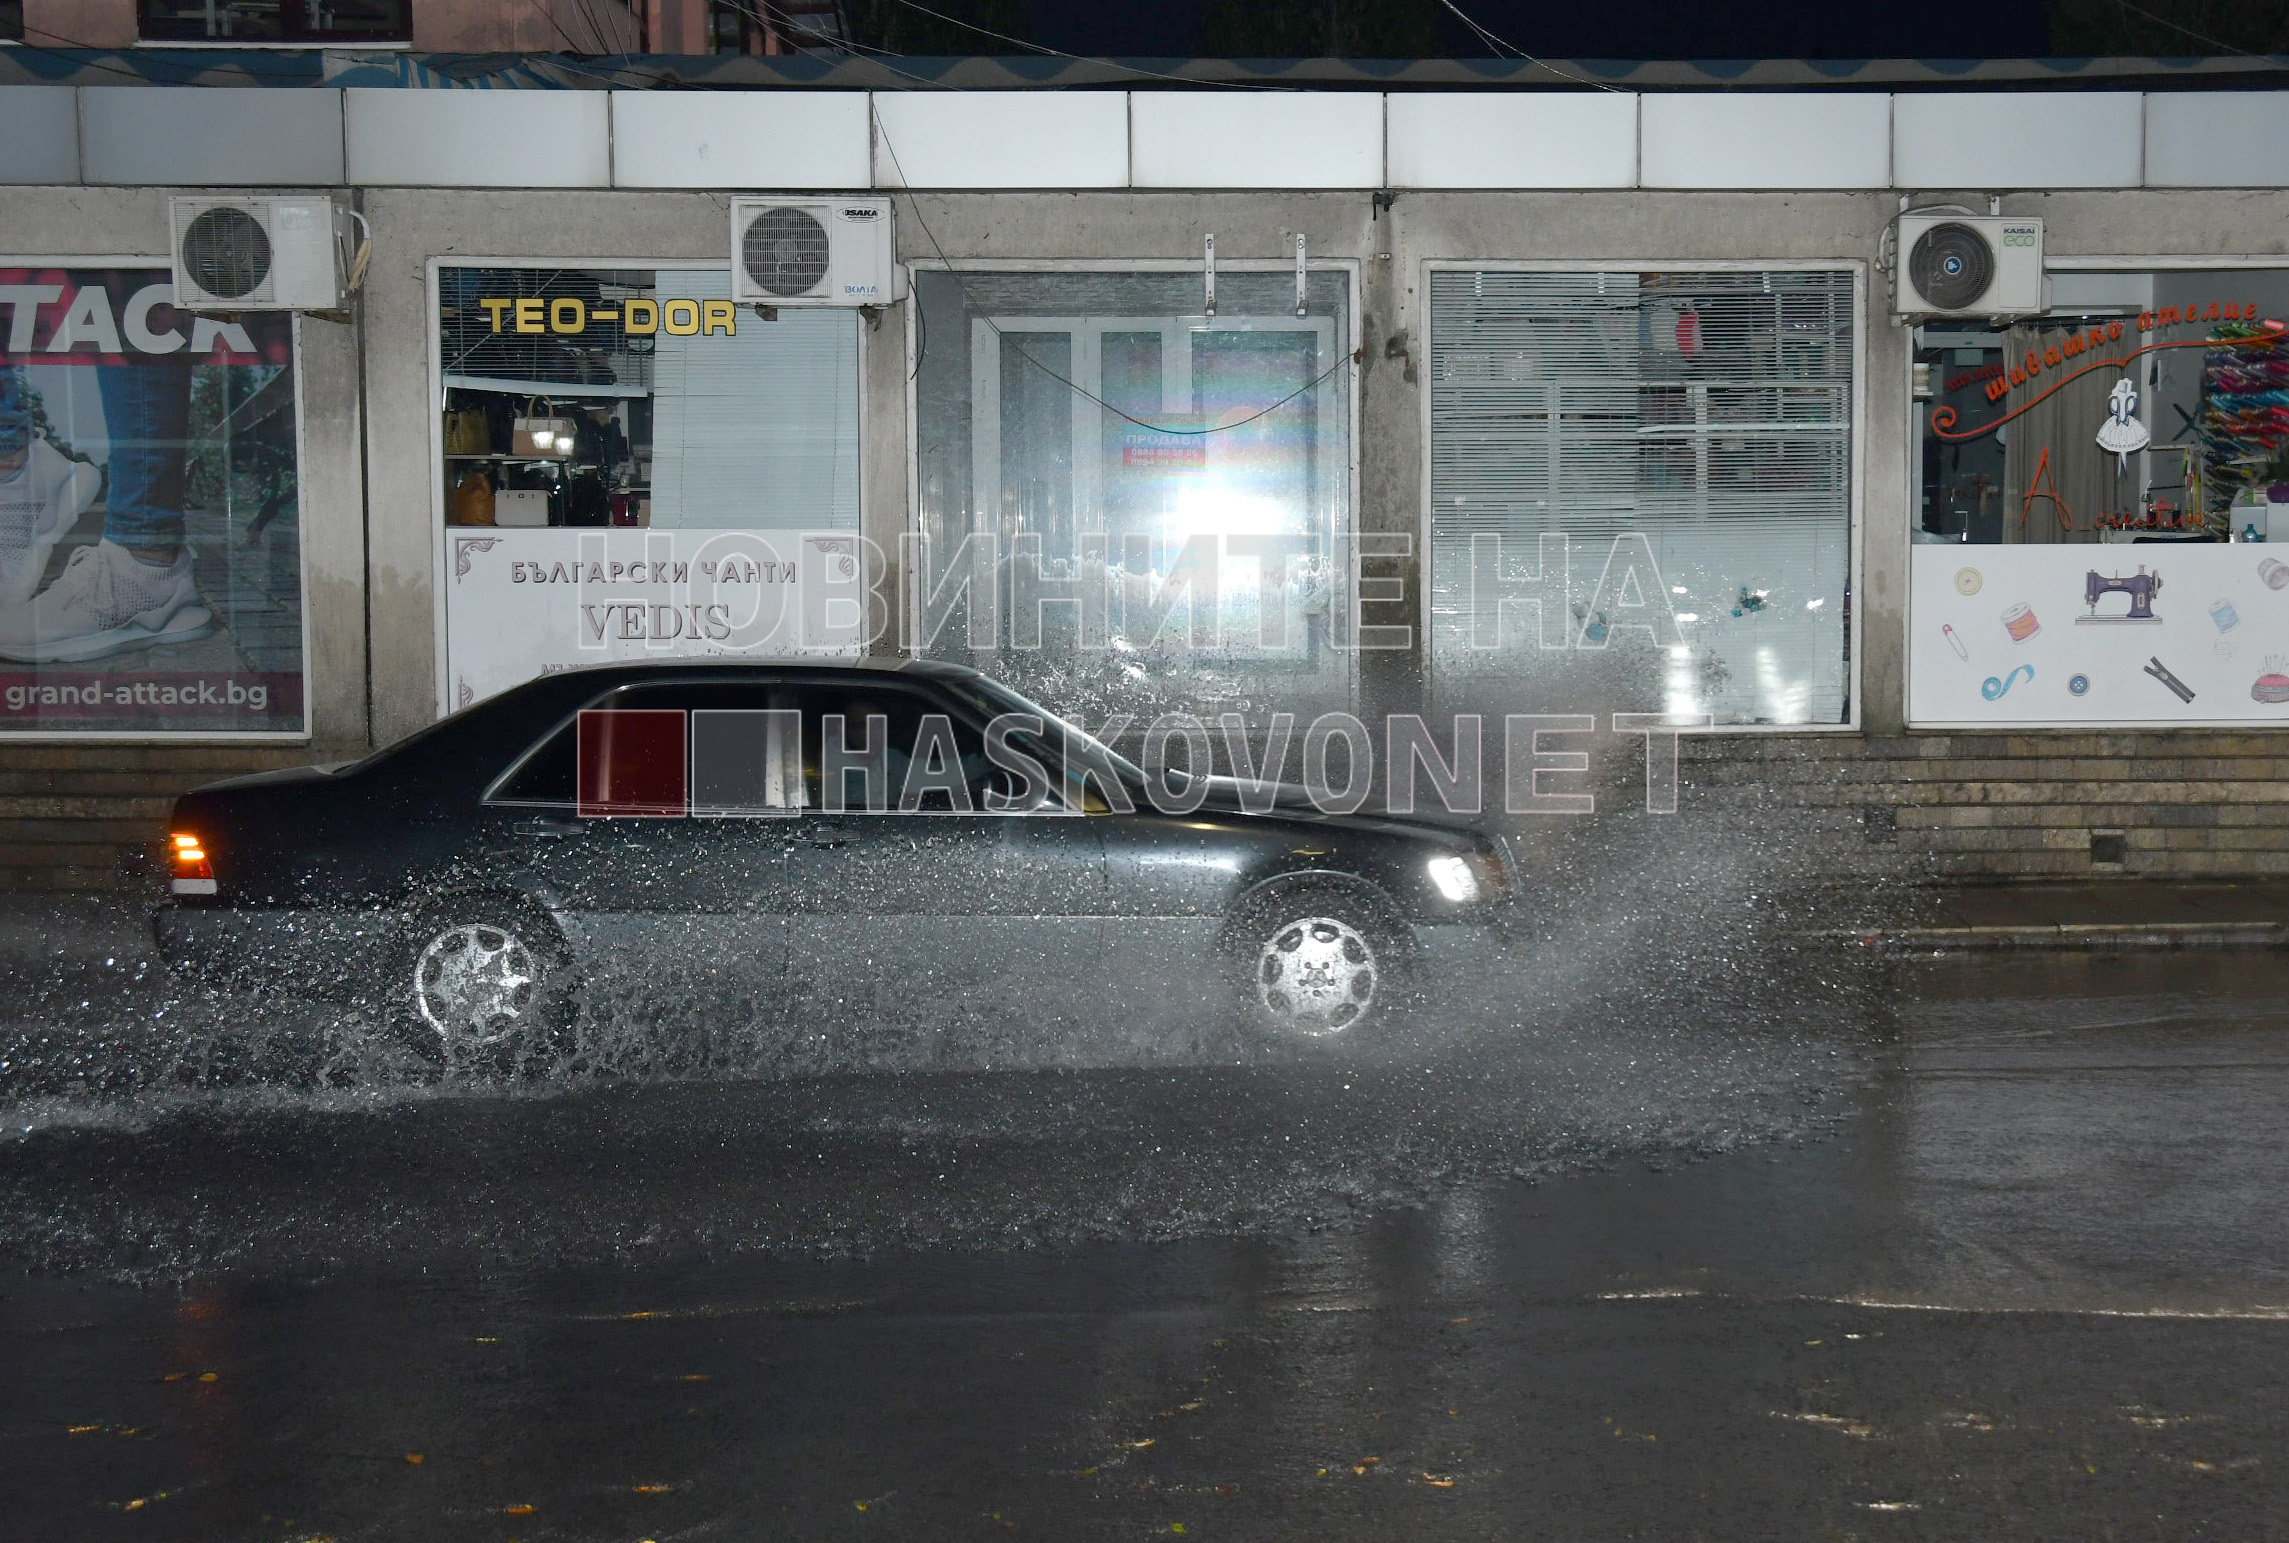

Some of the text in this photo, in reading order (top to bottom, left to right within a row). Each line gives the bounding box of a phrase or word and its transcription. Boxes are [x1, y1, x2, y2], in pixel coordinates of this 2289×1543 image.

[480, 298, 737, 336] TEO-DOR
[1985, 320, 2123, 402] шивашко
[2136, 301, 2257, 332] ателие
[511, 561, 797, 583] БЪЛГАРСКИ ЧАНТИ
[580, 604, 731, 640] VEDIS
[5, 680, 268, 711] grand-attack.bg
